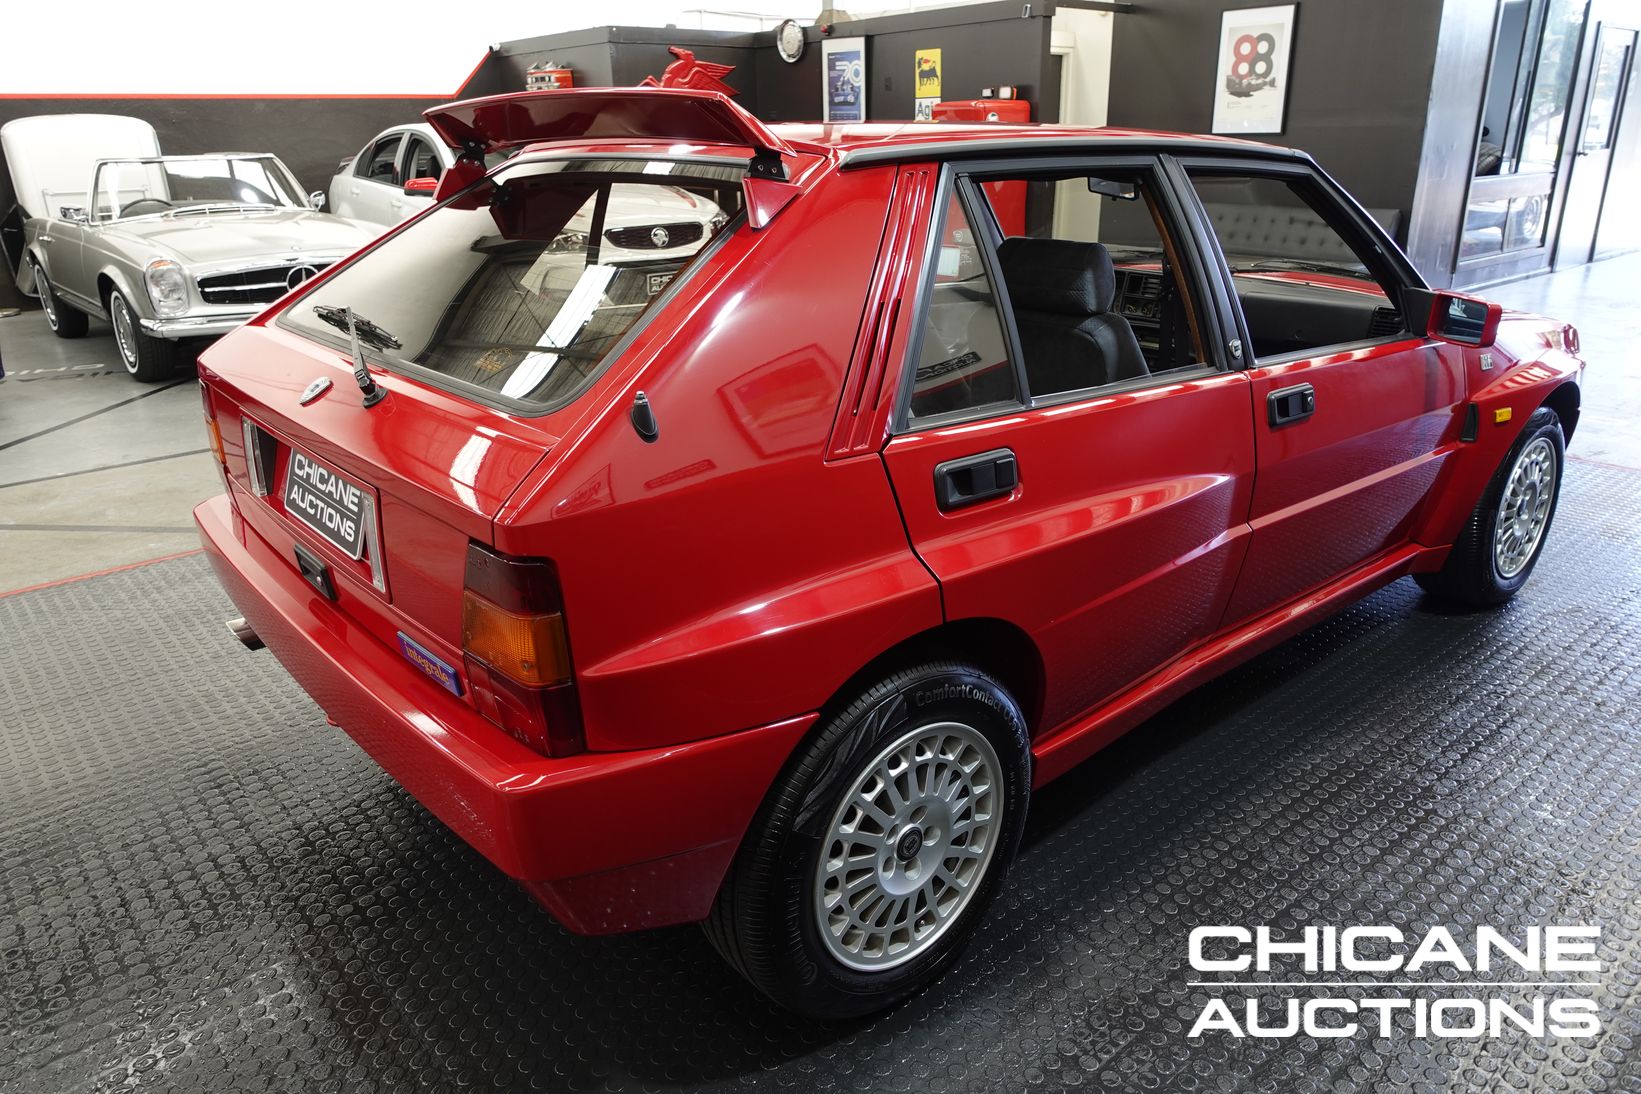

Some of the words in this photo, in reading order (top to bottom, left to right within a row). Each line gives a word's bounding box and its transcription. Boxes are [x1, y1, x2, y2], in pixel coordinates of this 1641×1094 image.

[835, 60, 863, 86] 70
[1232, 33, 1276, 81] 88
[294, 453, 361, 512] CHICANE
[290, 485, 356, 542] AUCTIONS
[403, 640, 450, 684] integrale
